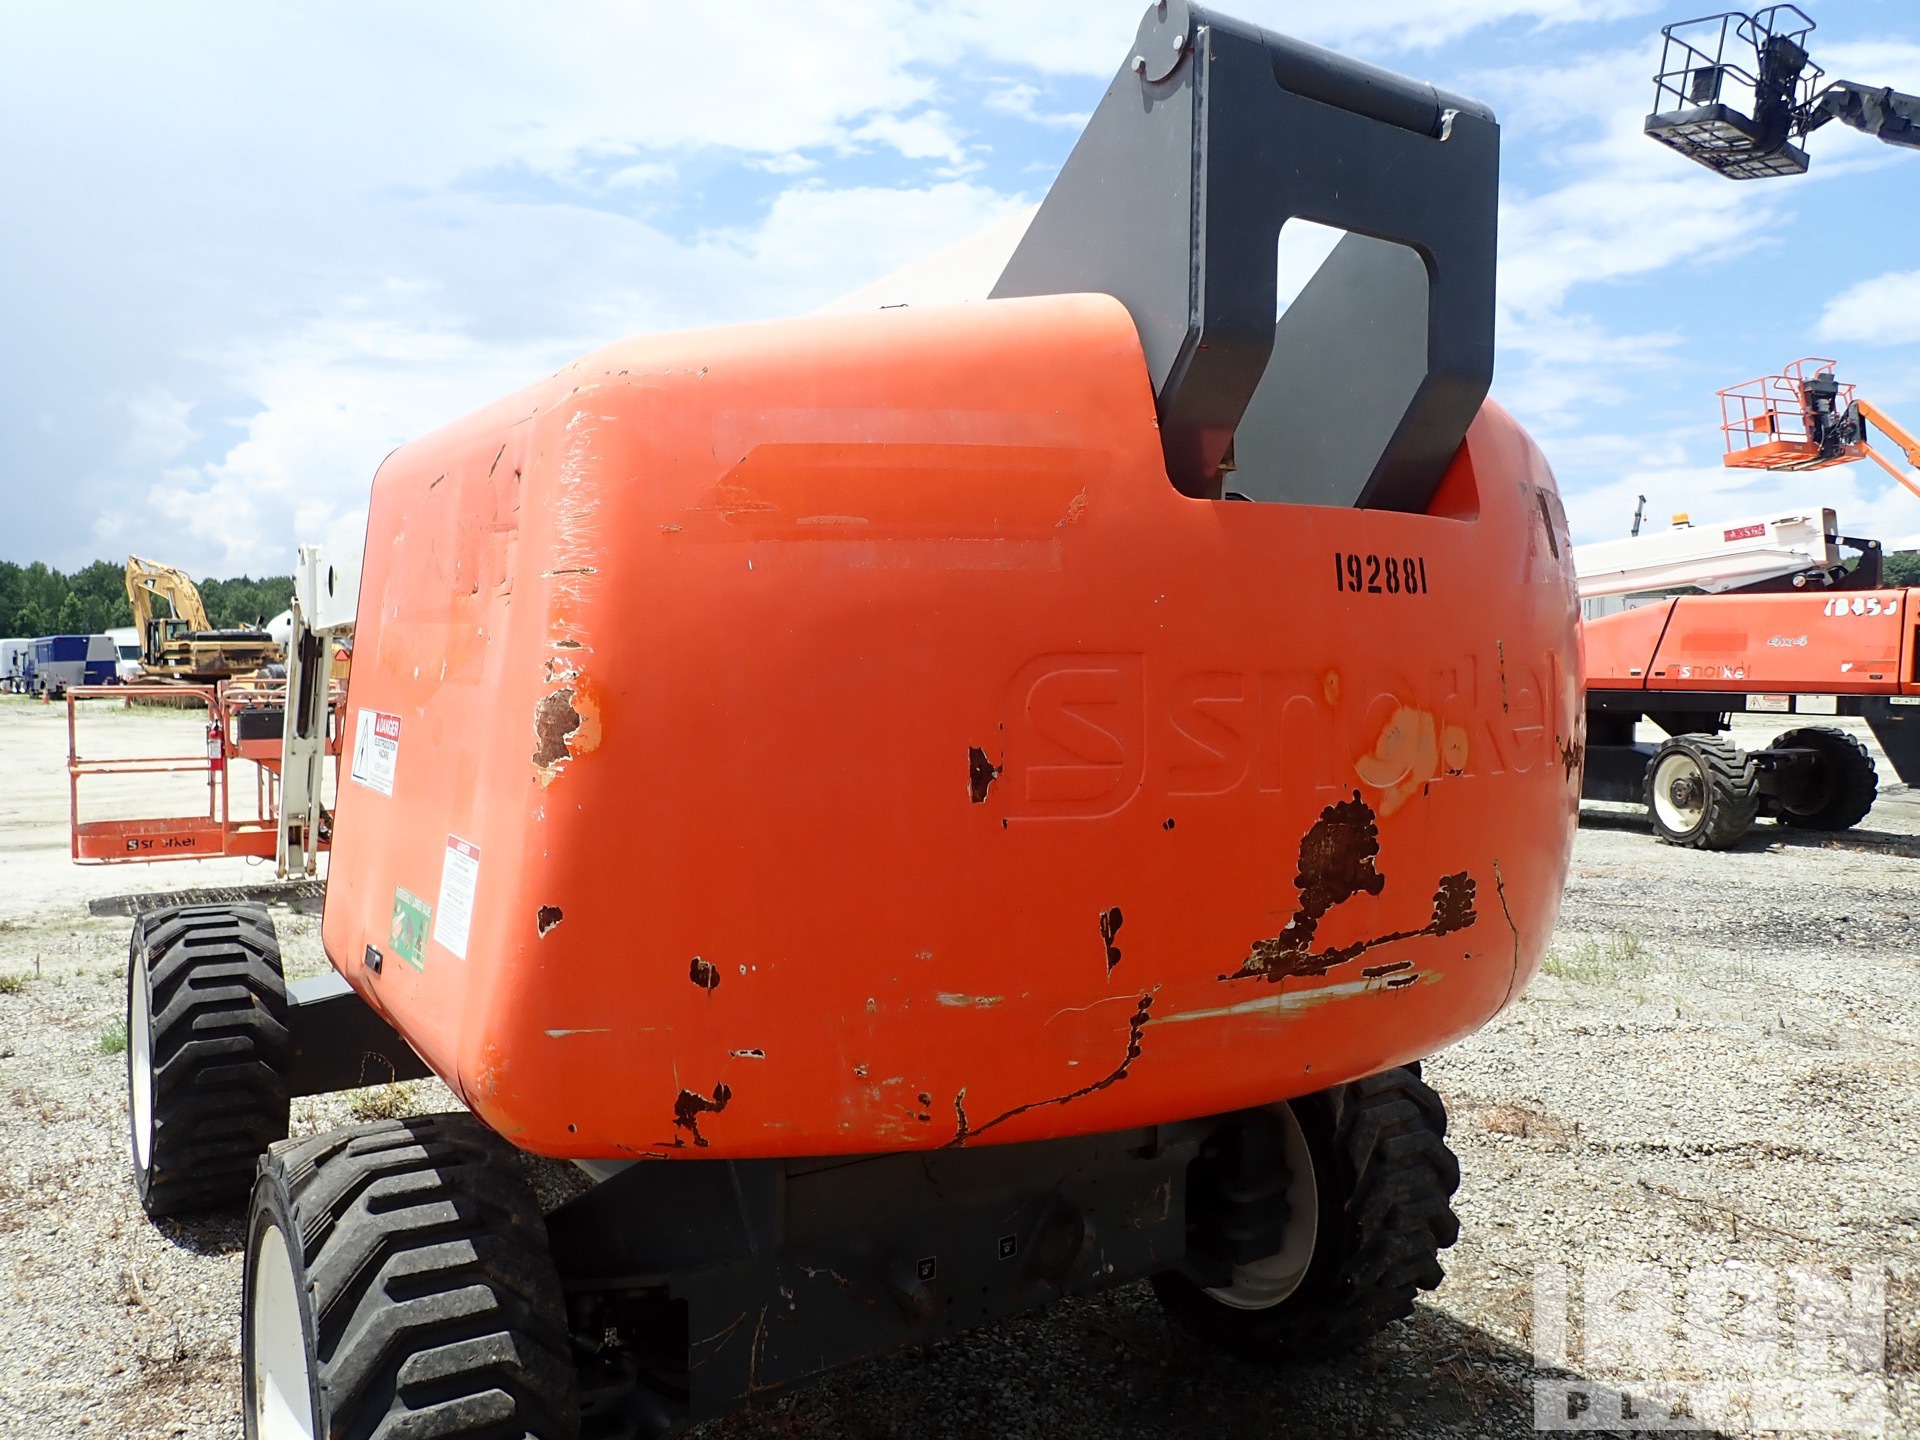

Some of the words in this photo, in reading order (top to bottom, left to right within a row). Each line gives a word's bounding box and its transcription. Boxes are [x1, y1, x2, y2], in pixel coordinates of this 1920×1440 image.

[1334, 552, 1428, 594] 192881
[1767, 635, 1808, 647] 4x4
[380, 718, 400, 738] DANGER
